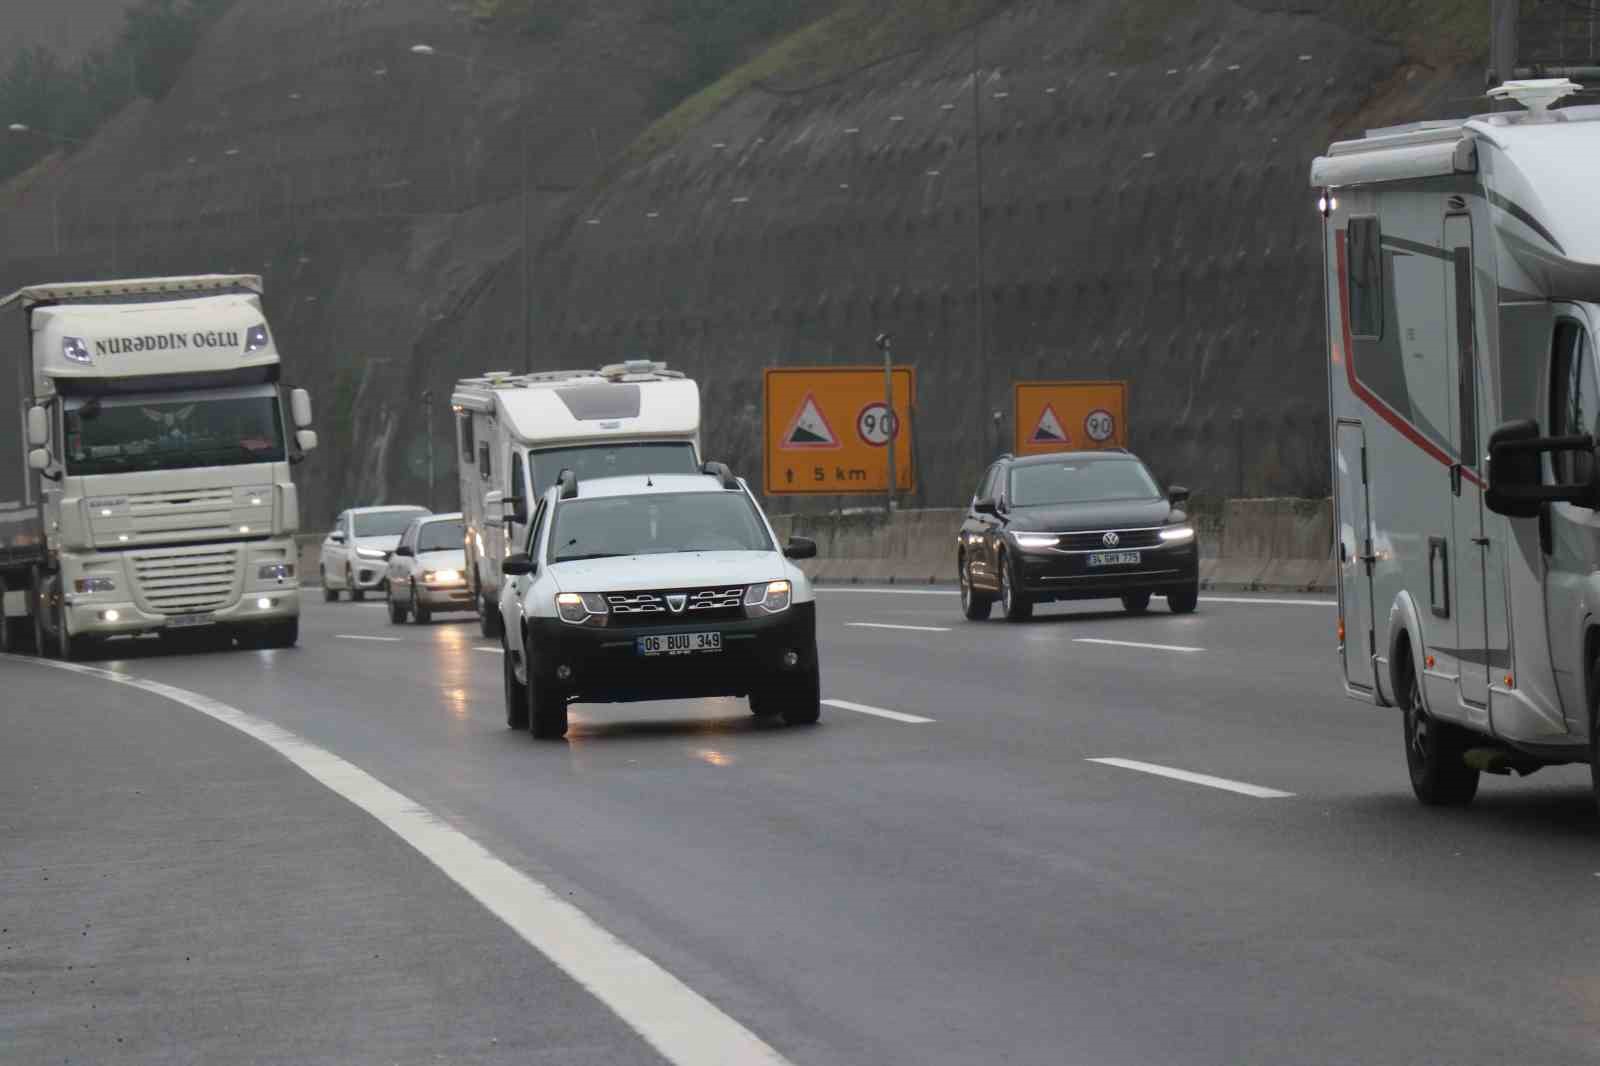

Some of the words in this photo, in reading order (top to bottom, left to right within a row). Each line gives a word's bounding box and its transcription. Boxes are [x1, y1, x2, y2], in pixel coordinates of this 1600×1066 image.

[864, 414, 893, 435] 90
[1090, 418, 1111, 435] 90
[814, 467, 825, 481] 5
[835, 467, 867, 481] km
[645, 637, 660, 650] 06
[697, 633, 720, 648] 349
